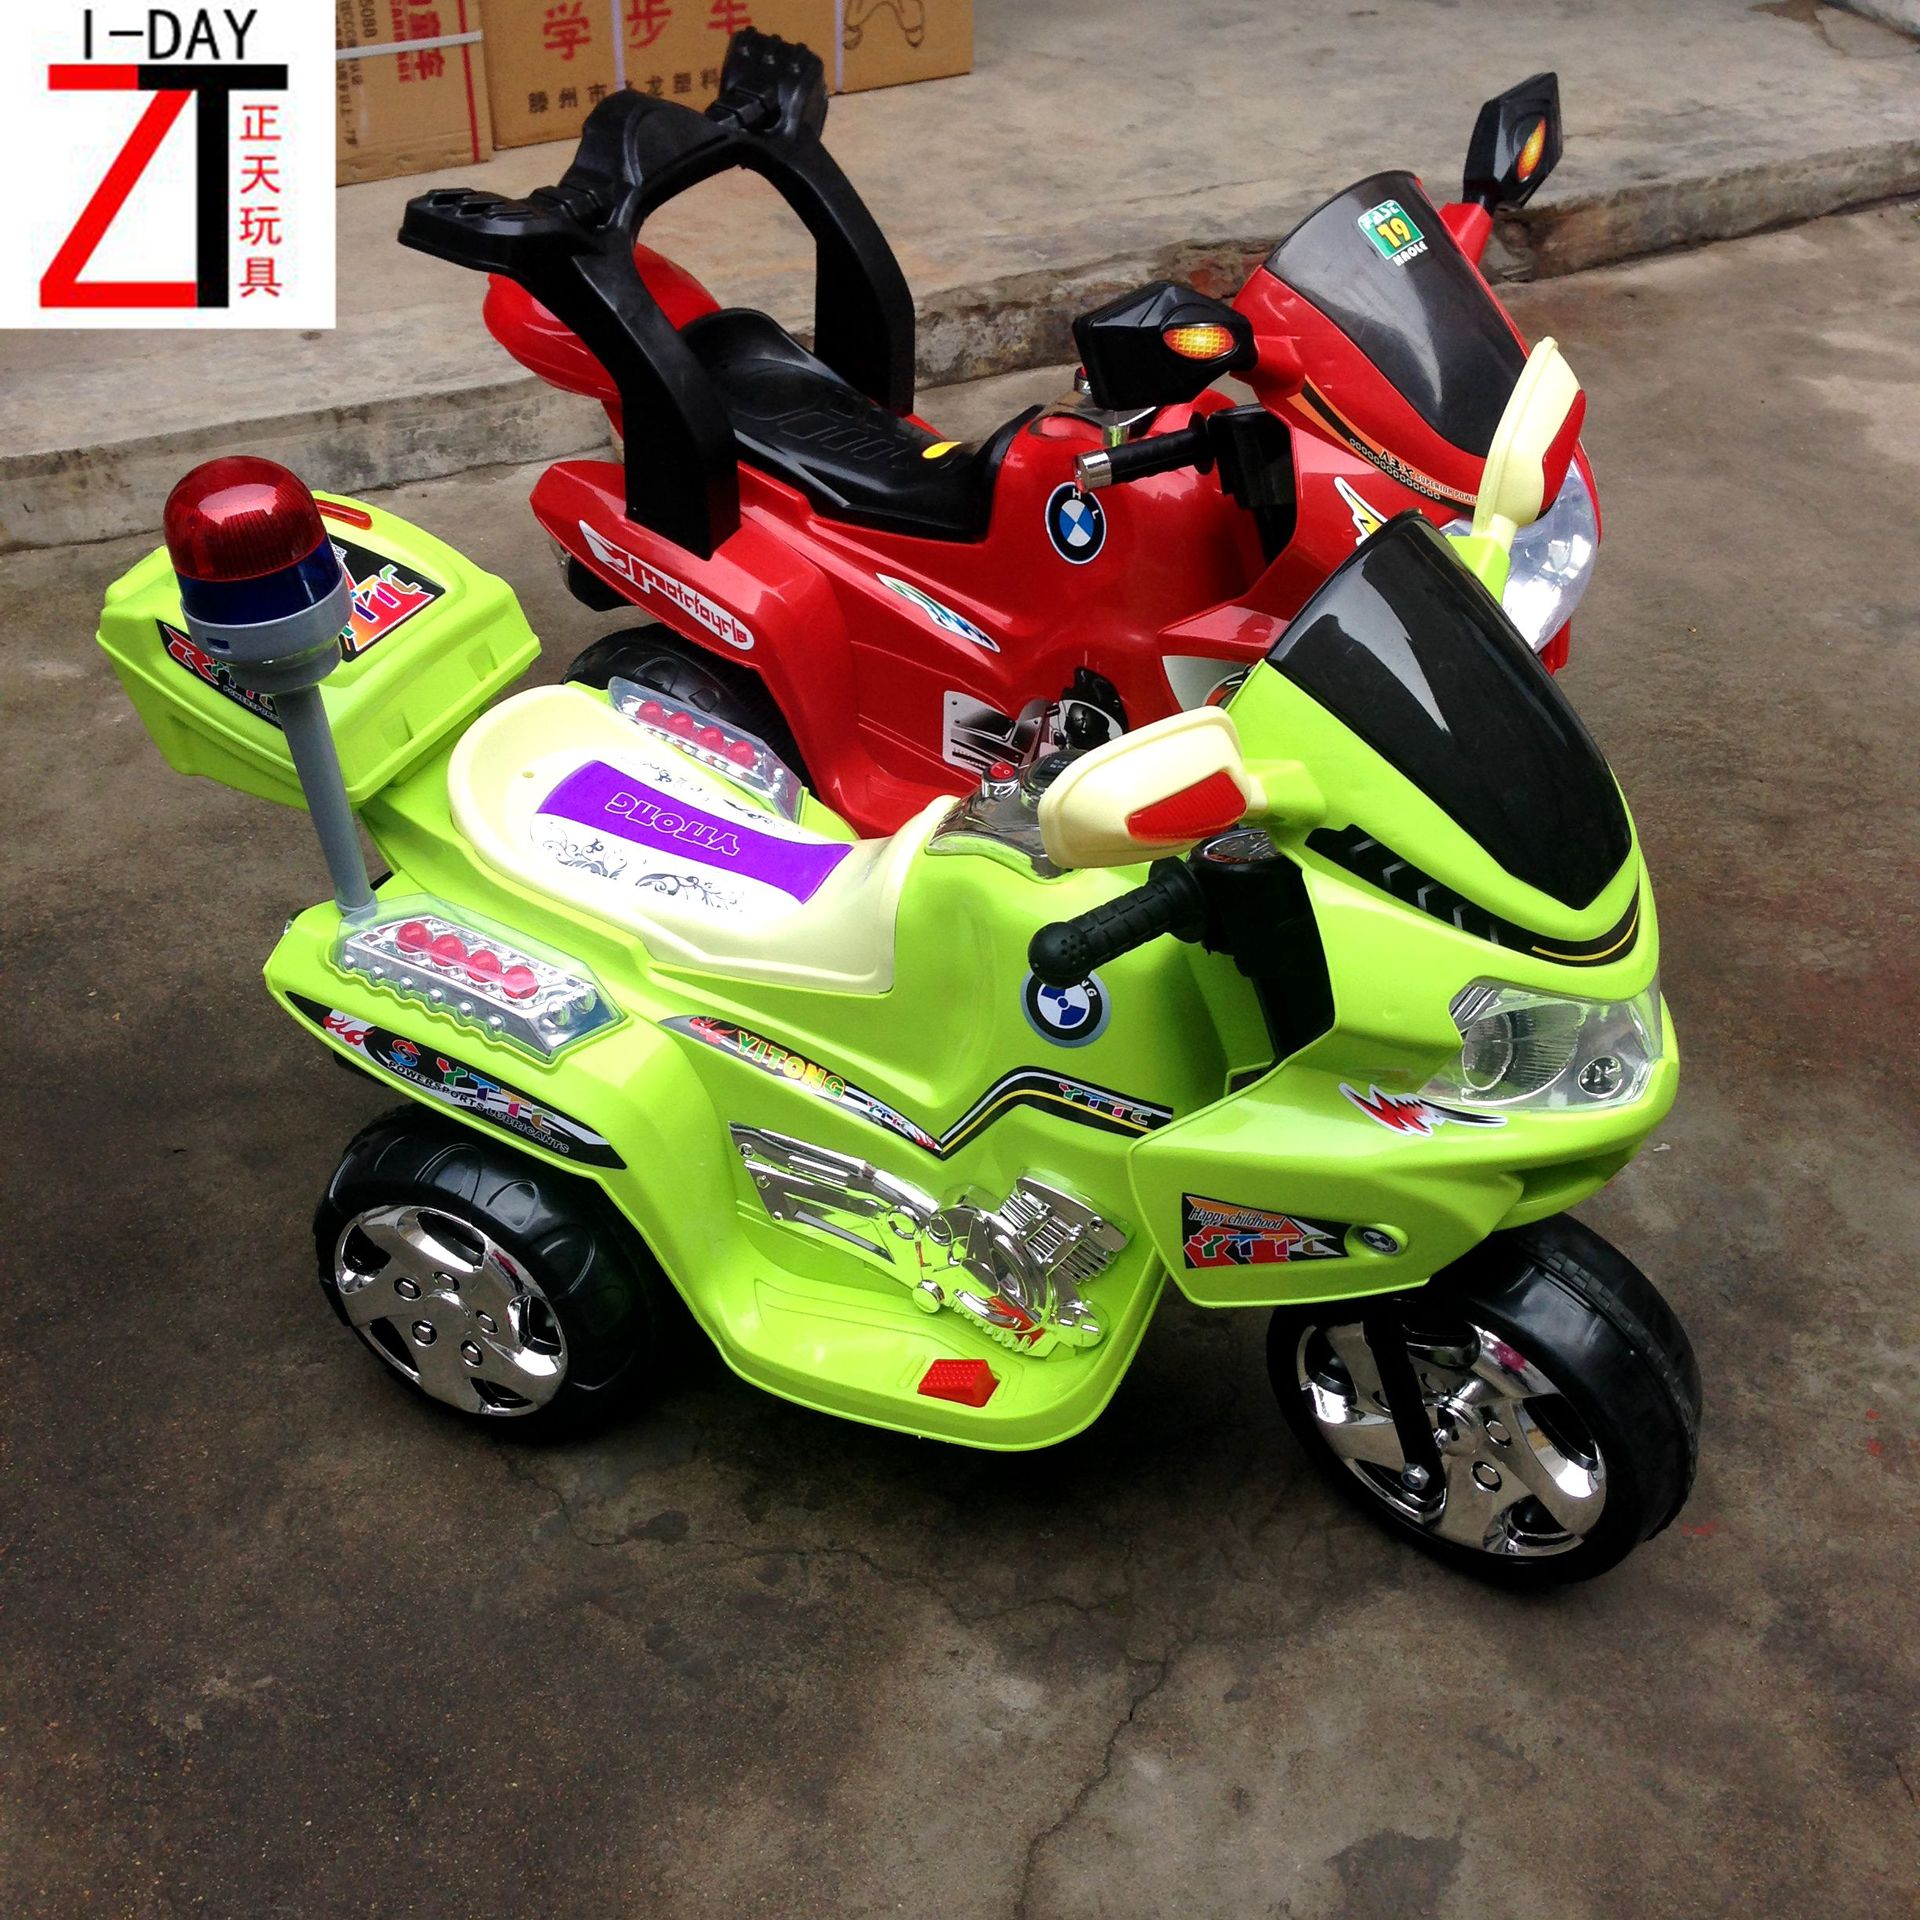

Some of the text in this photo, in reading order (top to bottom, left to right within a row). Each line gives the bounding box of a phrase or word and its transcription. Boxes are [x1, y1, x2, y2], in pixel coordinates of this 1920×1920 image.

[1376, 217, 1412, 249] 19
[386, 1060, 485, 1113] POWERSPORTS
[736, 1029, 847, 1101] YITONG
[1058, 1083, 1152, 1126] YTTC
[1188, 1206, 1287, 1231] Happy childhood
